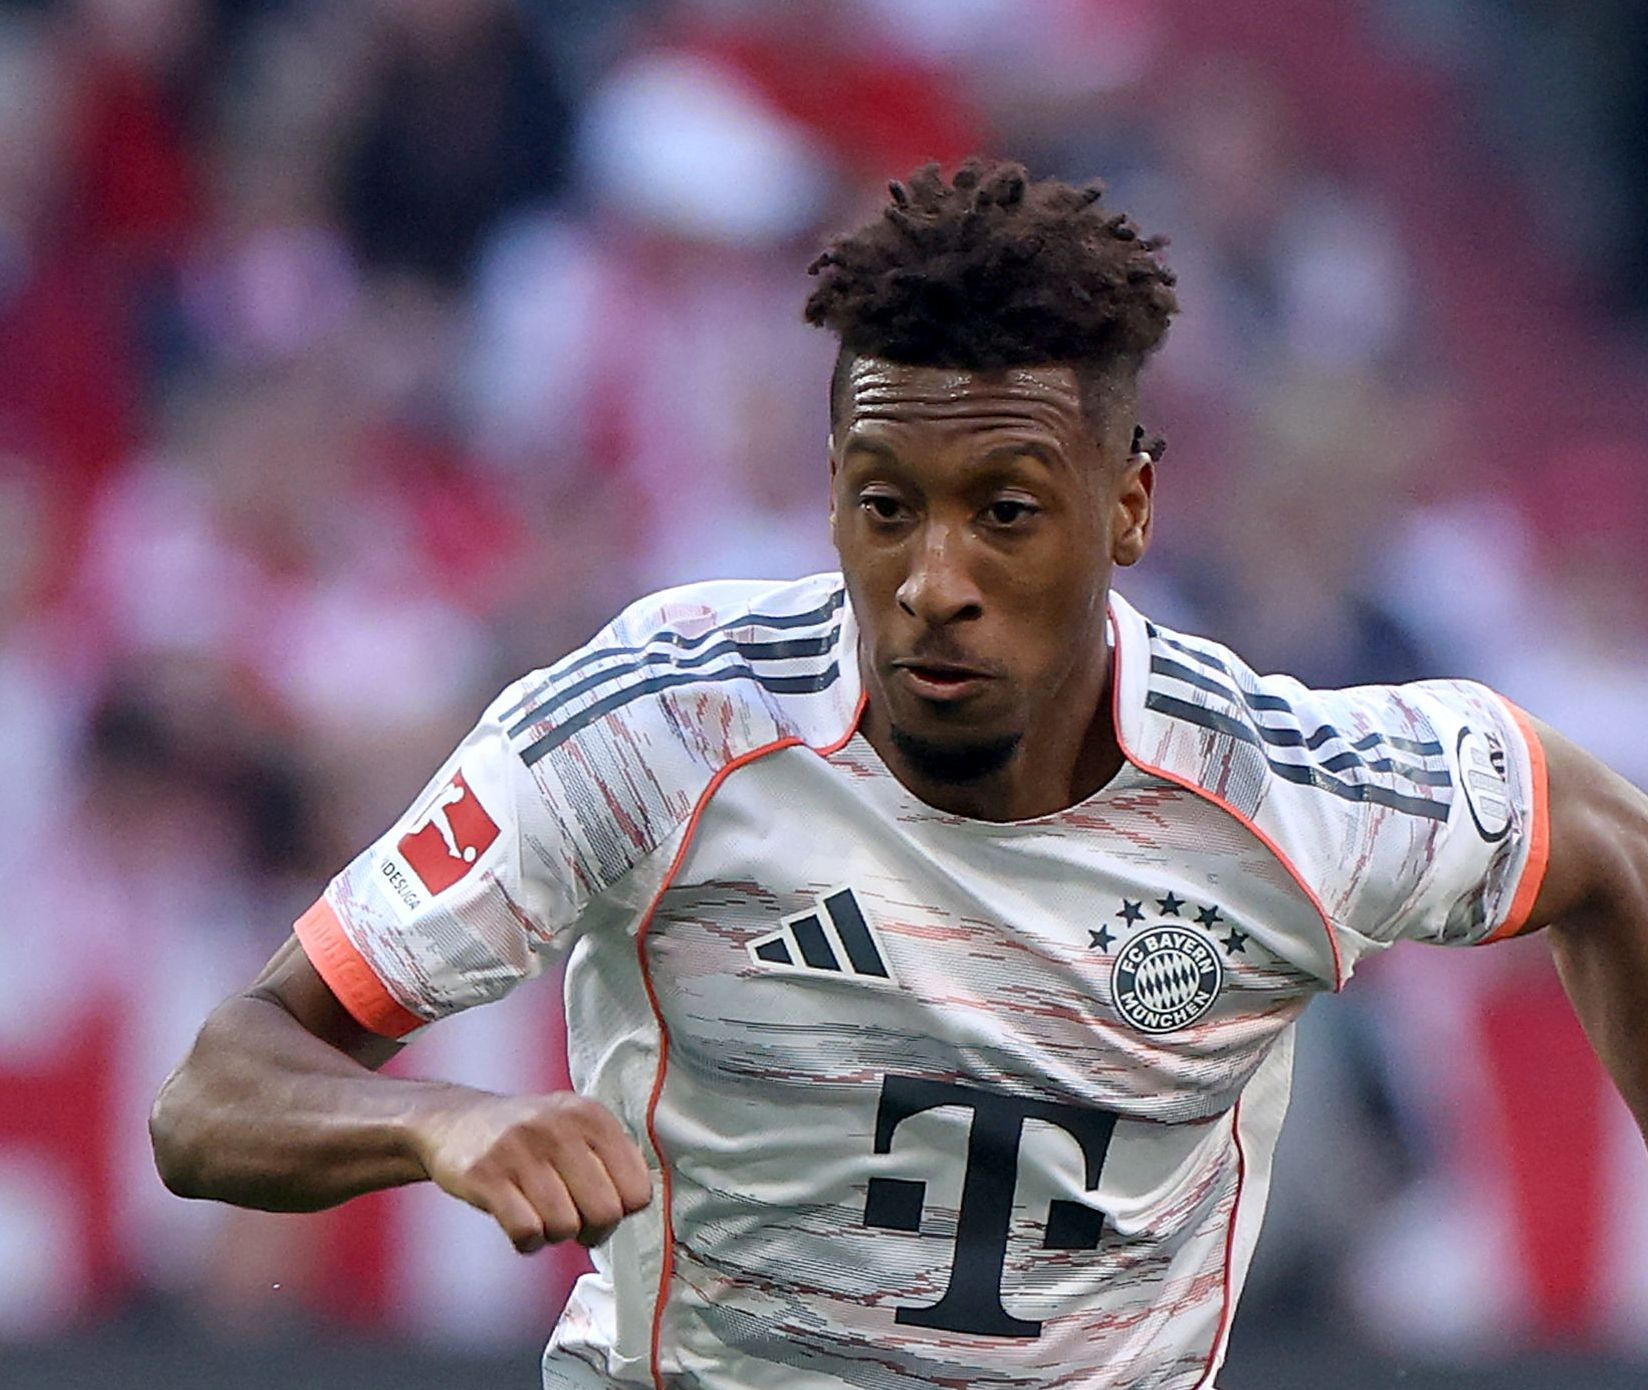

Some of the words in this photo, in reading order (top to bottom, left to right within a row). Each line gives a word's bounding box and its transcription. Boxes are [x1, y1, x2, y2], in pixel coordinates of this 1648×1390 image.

[1120, 947, 1145, 974] FC
[1144, 933, 1215, 975] BAYERN
[863, 1074, 1119, 1338] T
